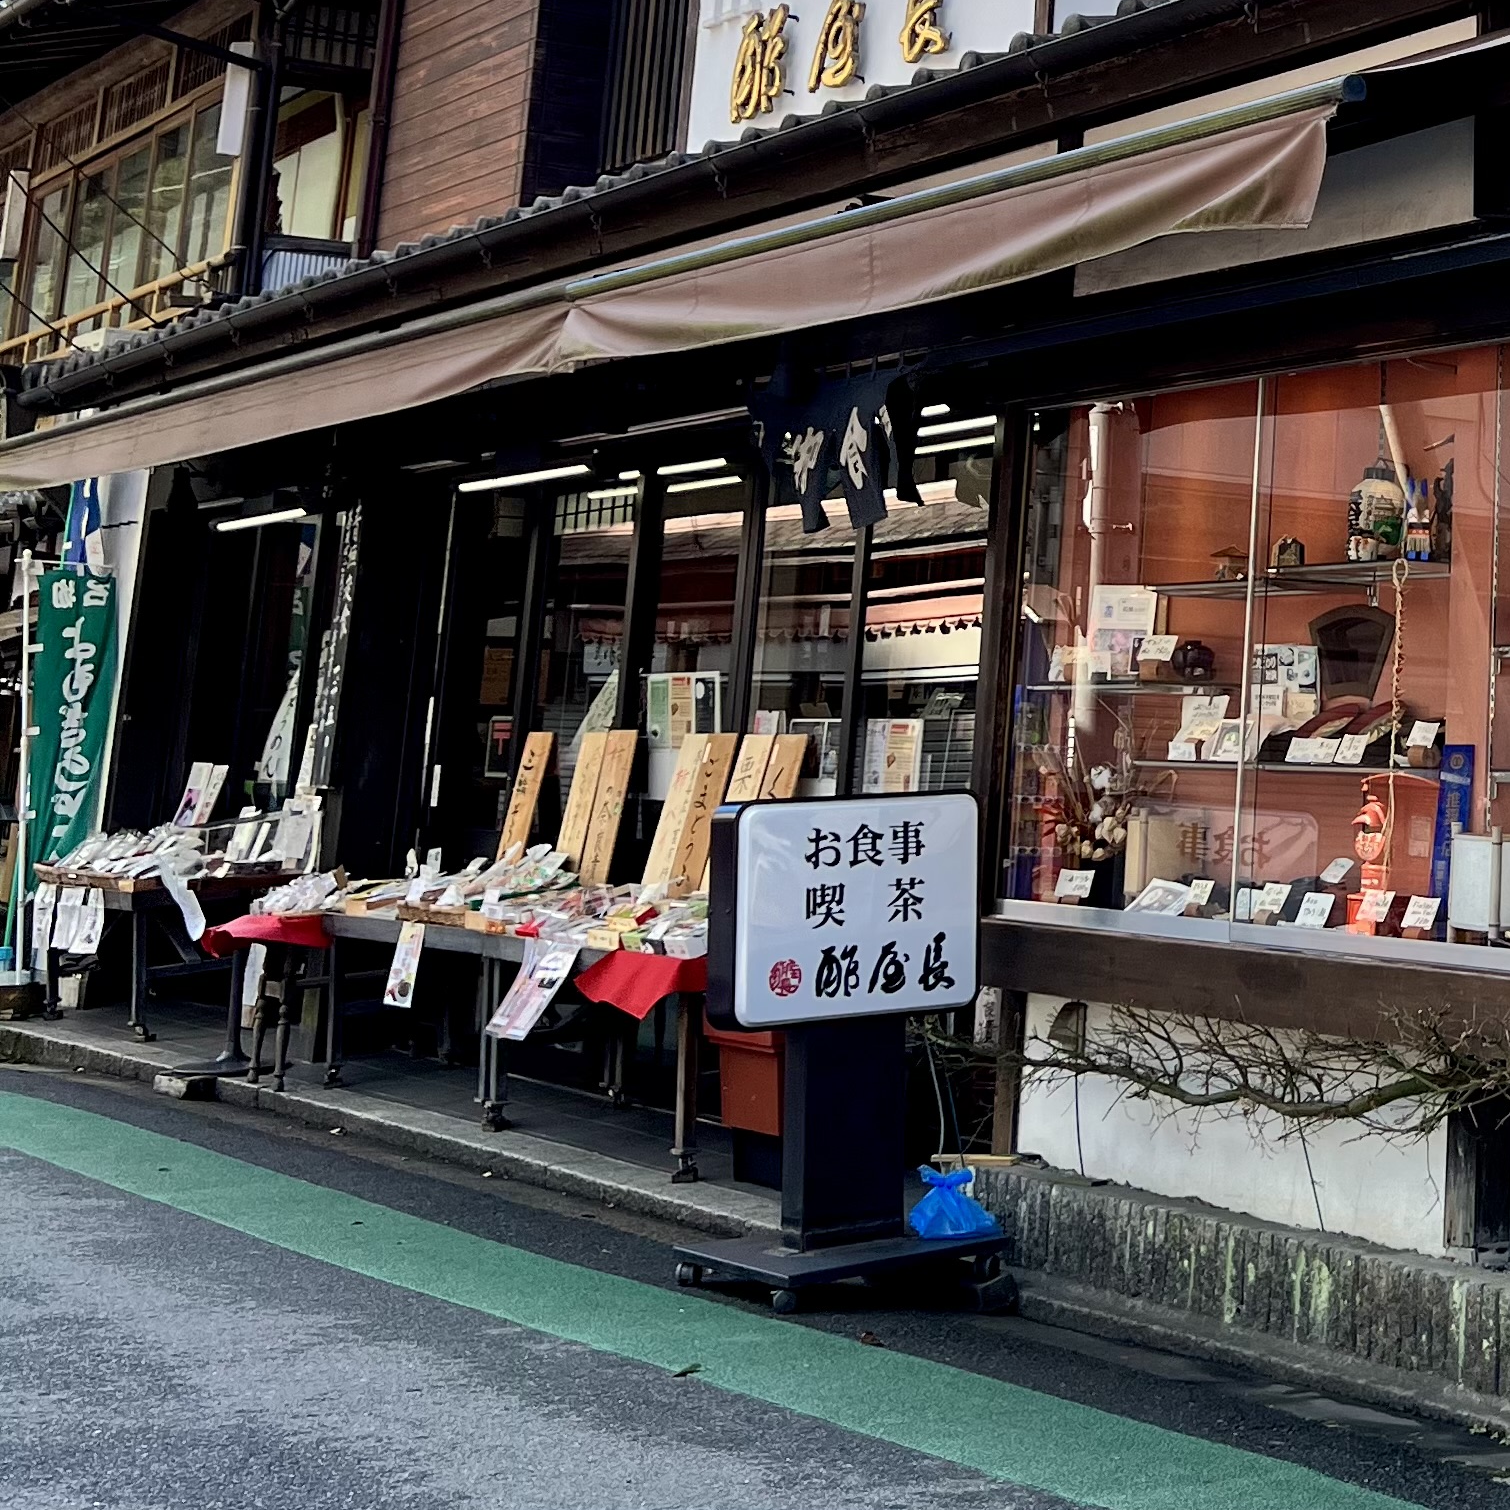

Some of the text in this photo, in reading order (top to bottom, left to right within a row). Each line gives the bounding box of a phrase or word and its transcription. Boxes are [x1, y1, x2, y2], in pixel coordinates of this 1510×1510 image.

[804, 820, 926, 870] お食事
[804, 877, 926, 930] 喫茶
[814, 931, 956, 999] 酢屋長
